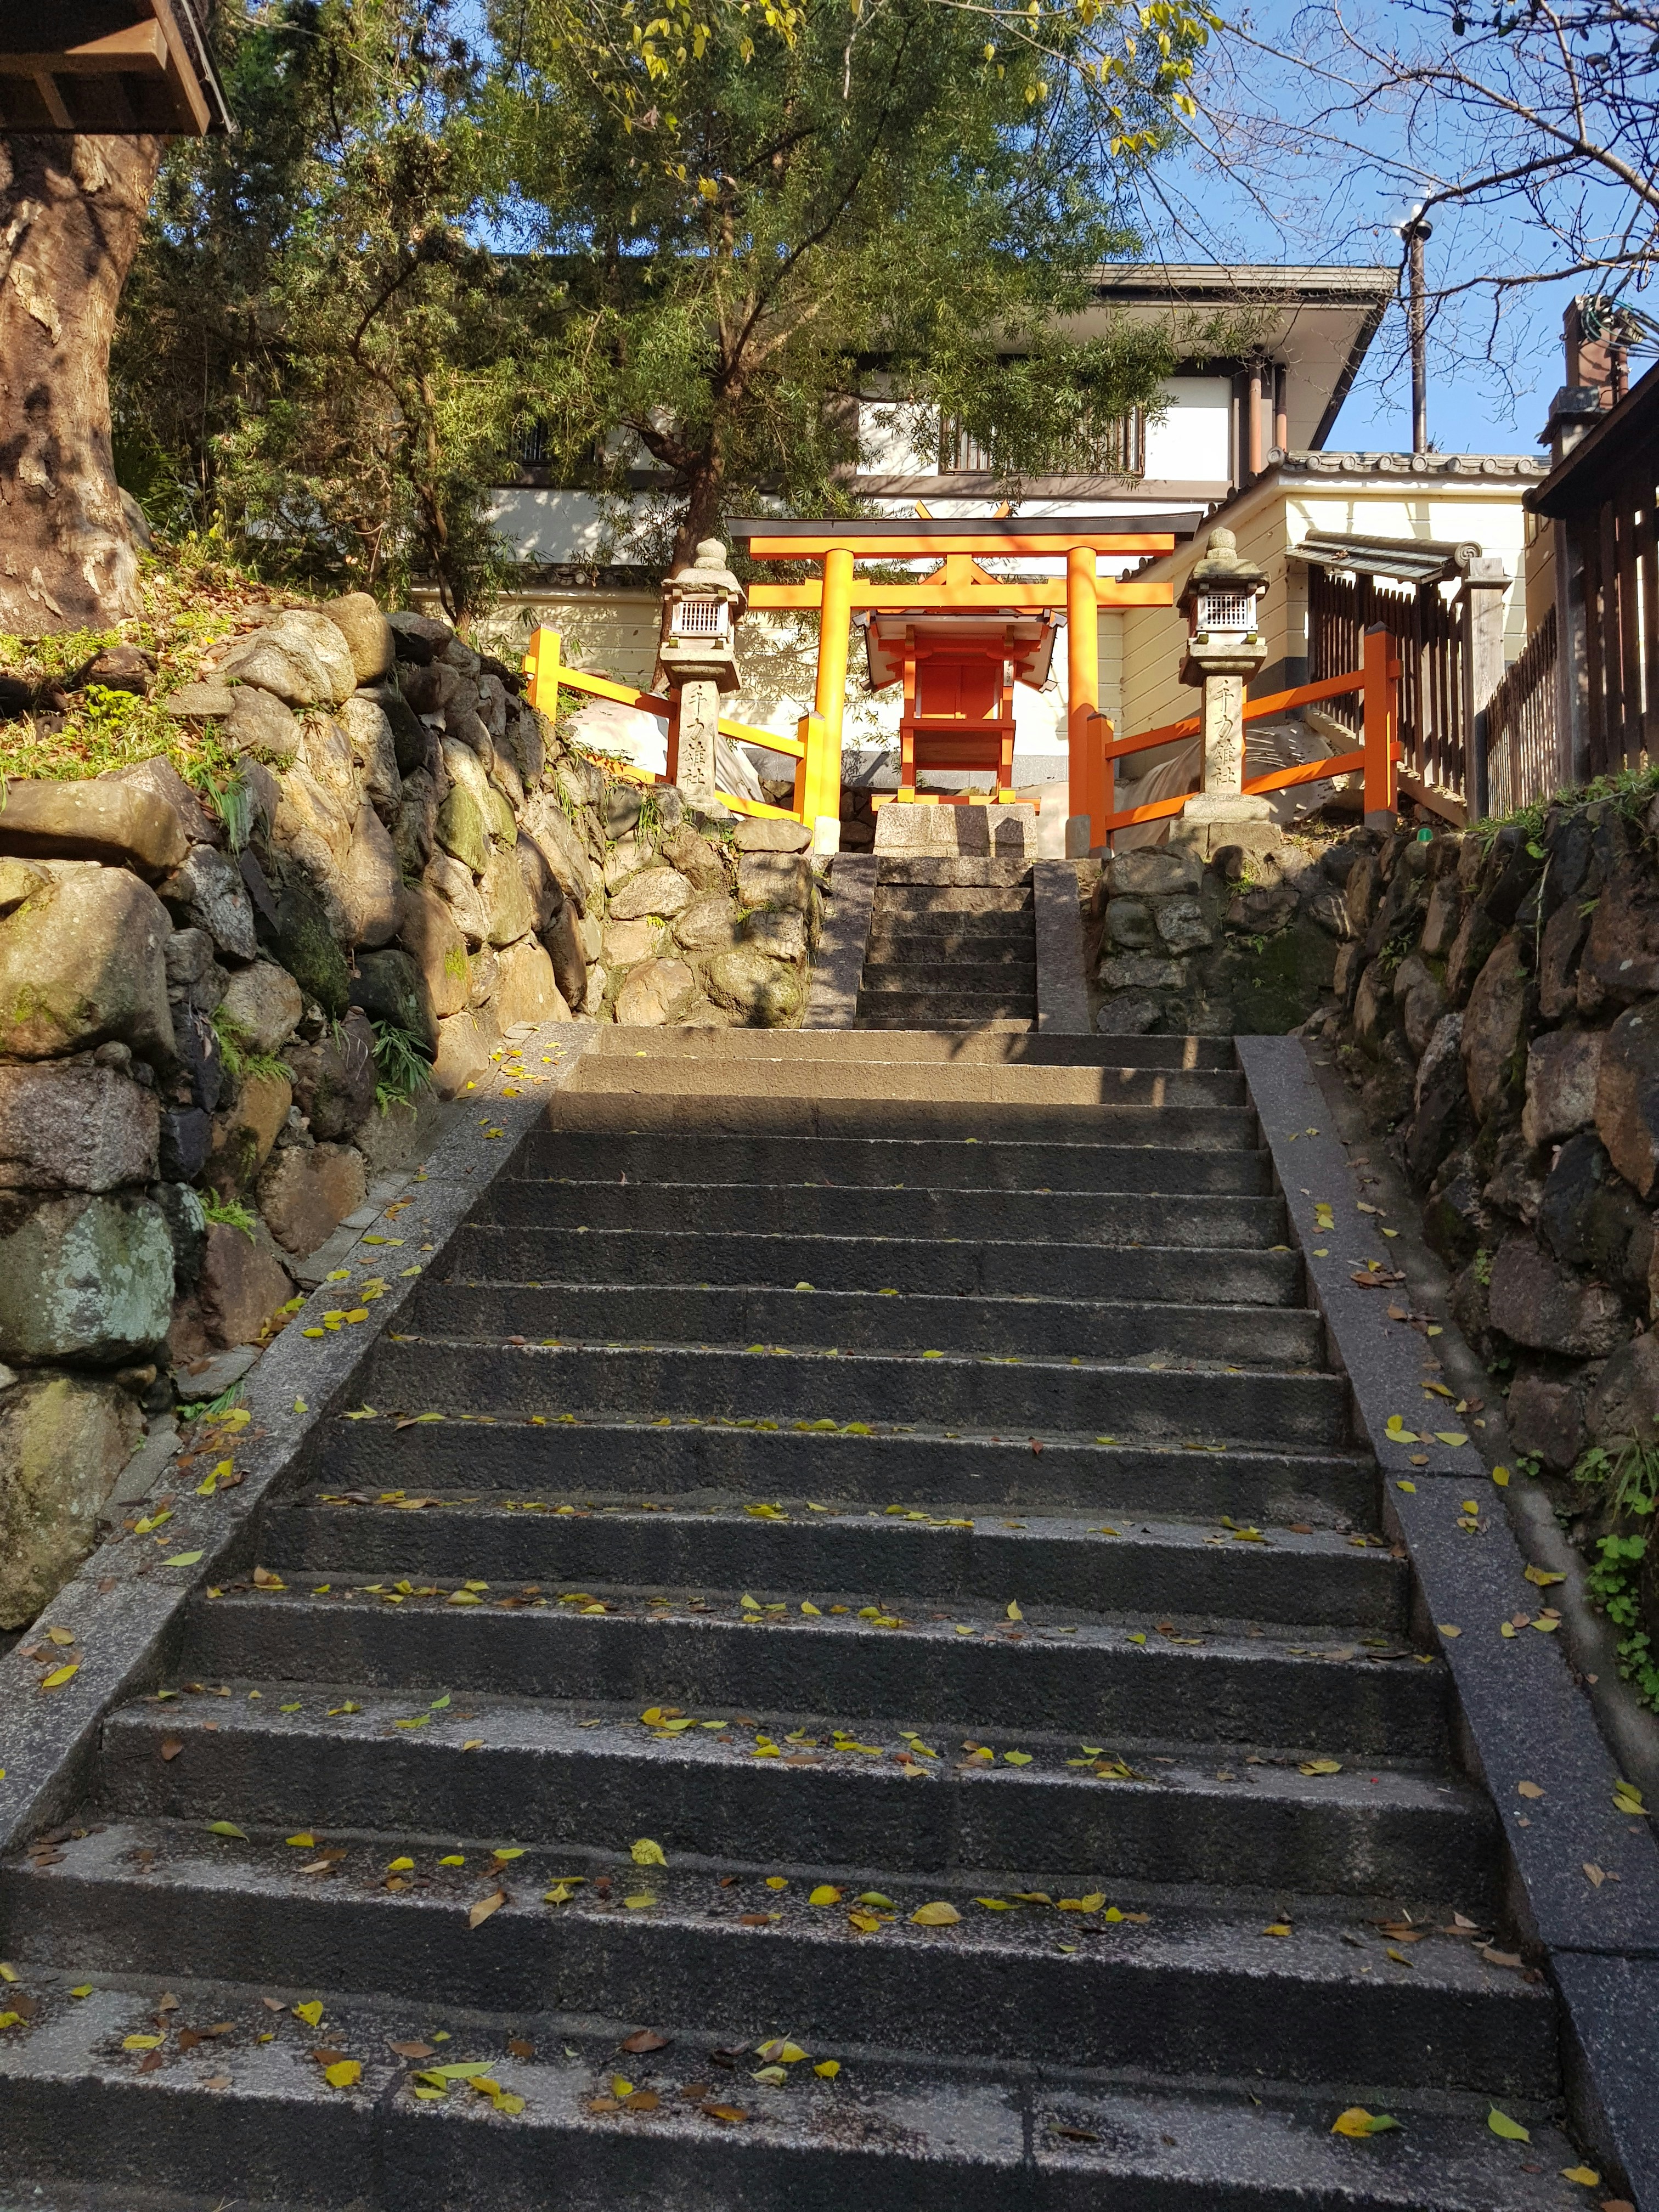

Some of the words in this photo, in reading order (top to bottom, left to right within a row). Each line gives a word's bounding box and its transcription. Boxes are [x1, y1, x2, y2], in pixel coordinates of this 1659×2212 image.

[681, 684, 707, 787] 手力雄社
[1211, 679, 1236, 786] 手力雄社
